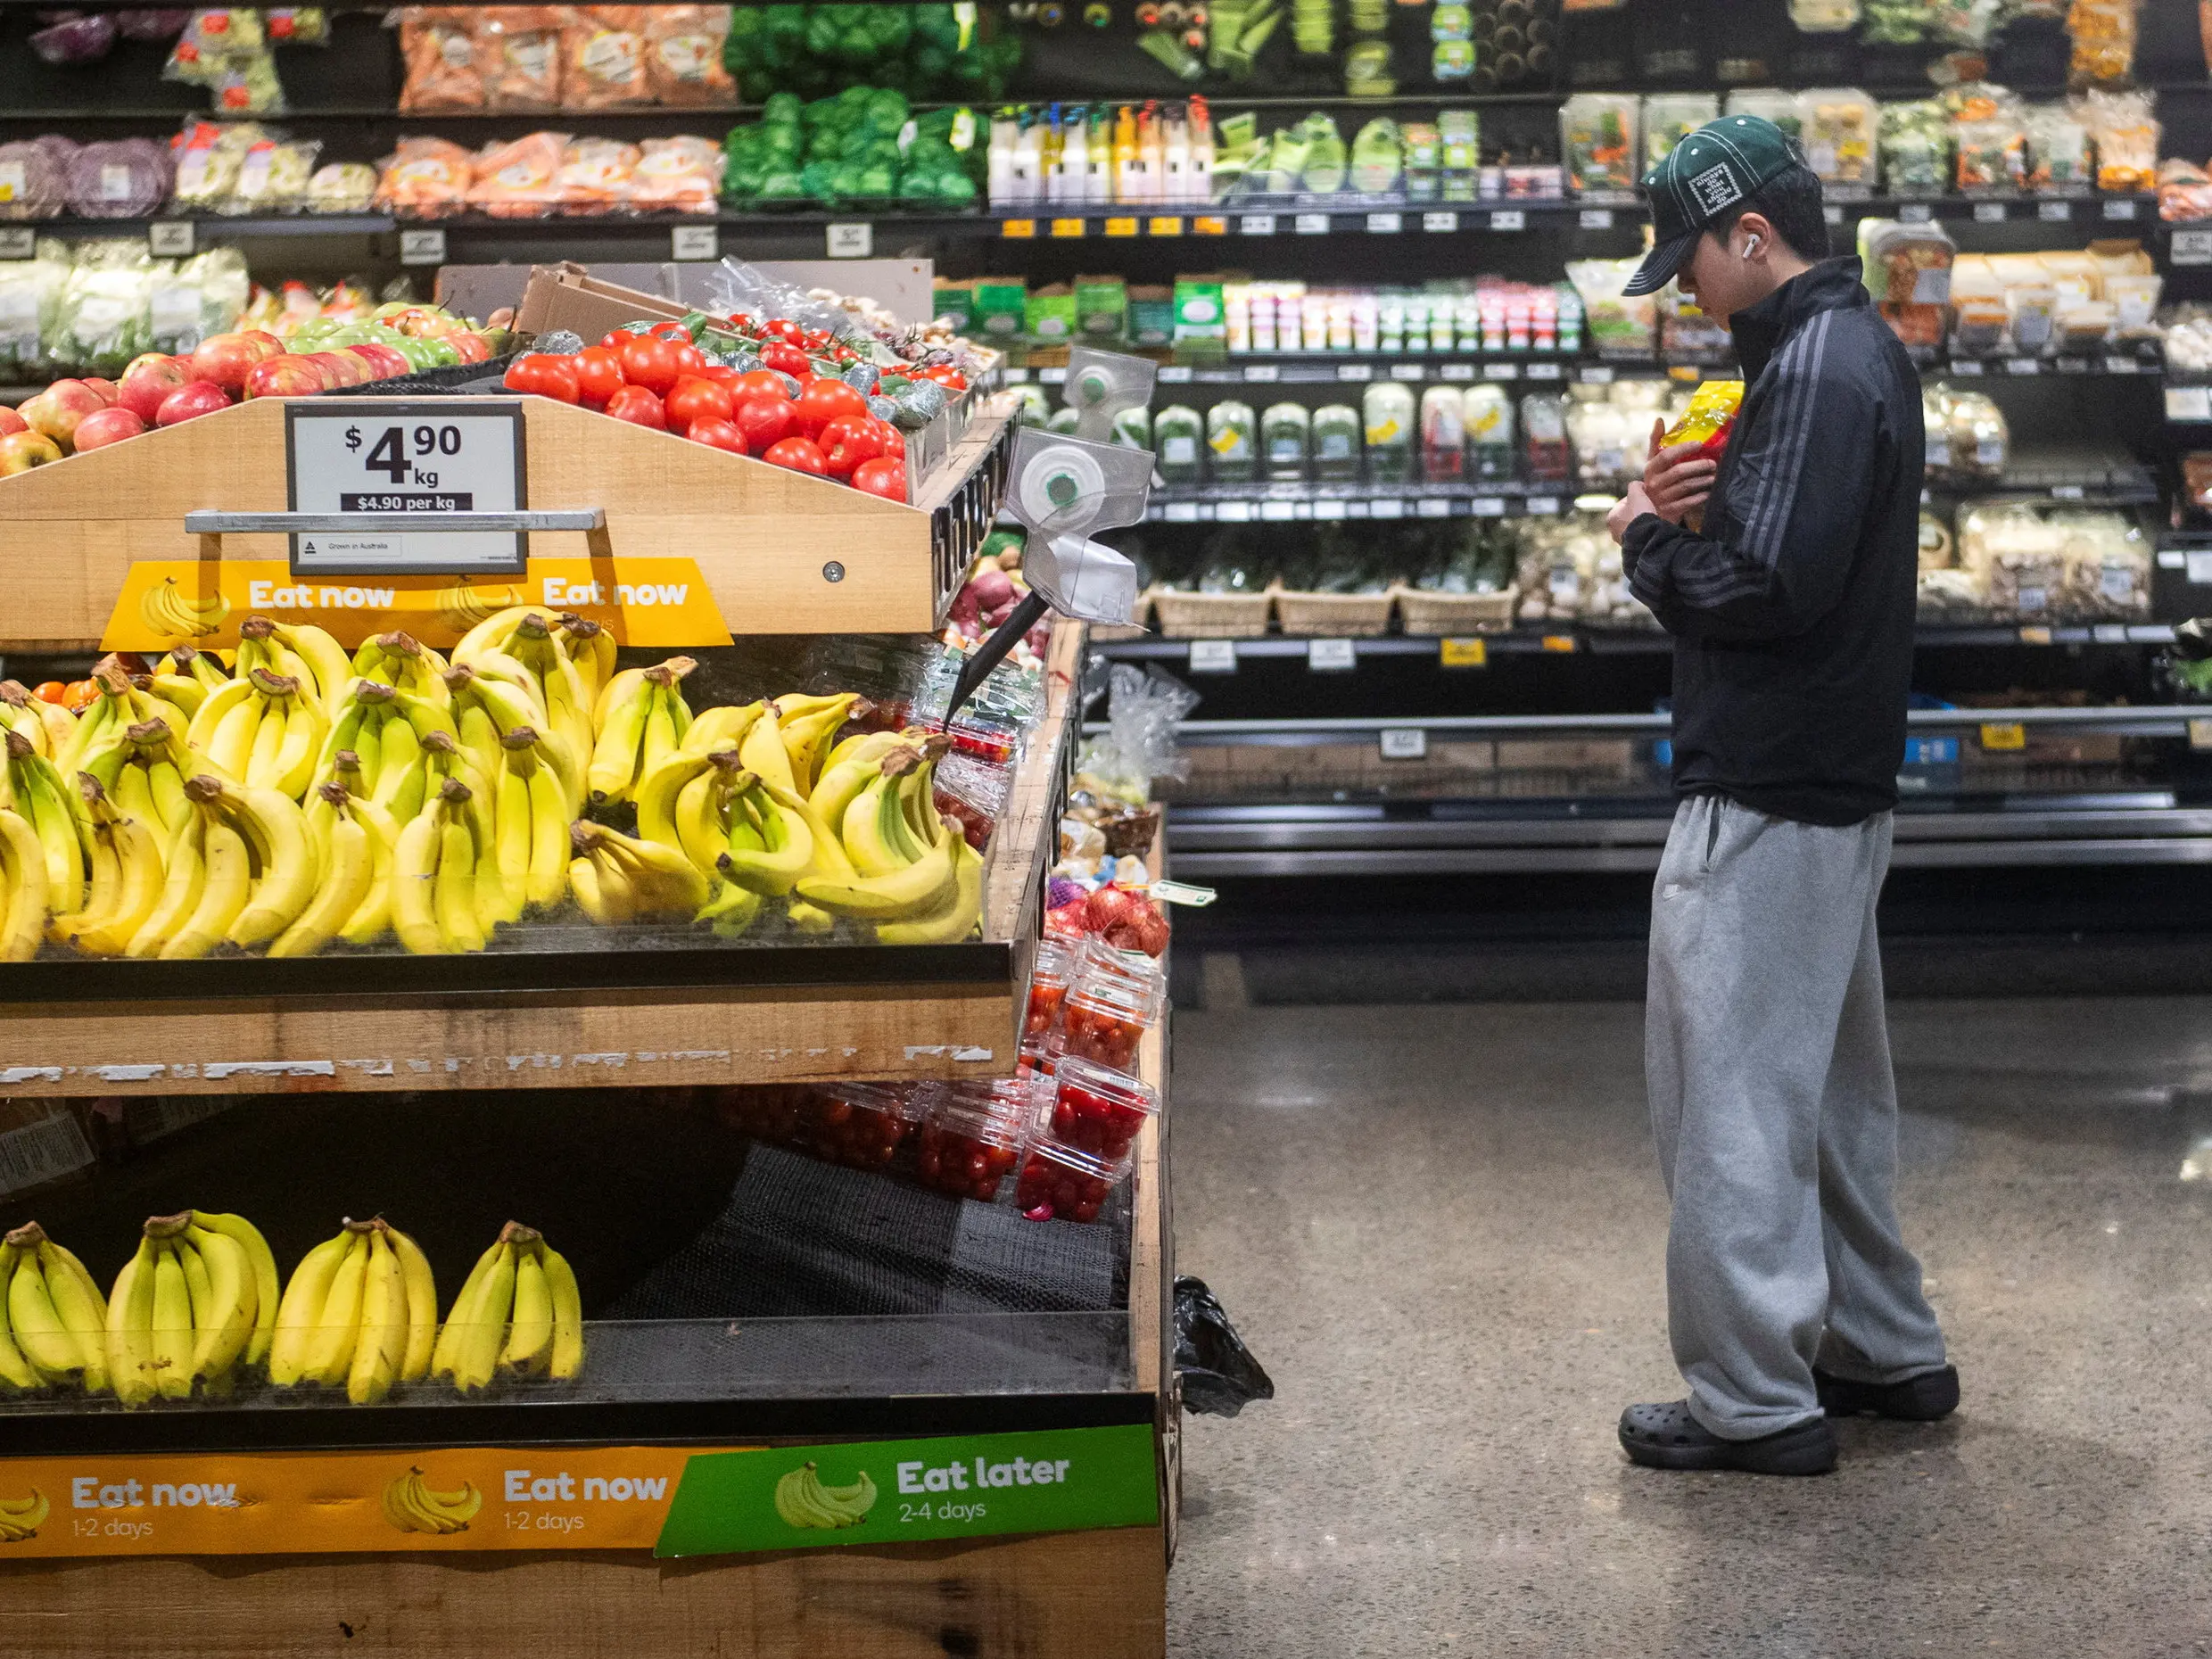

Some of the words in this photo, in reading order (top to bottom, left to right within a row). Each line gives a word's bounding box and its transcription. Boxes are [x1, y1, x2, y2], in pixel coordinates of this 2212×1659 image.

[1696, 169, 1723, 186] always
[1704, 178, 1725, 194] what
[415, 468, 438, 488] kg
[358, 496, 401, 511] $4.90
[406, 499, 433, 511] per
[436, 496, 456, 511] kg
[250, 581, 313, 608] Eat
[319, 587, 395, 608] now
[542, 578, 606, 606] Eat
[613, 584, 688, 606] now
[504, 1470, 576, 1501] Eat
[583, 1477, 668, 1501] now
[896, 1461, 969, 1494] Eat
[975, 1457, 1069, 1488] later
[72, 1477, 144, 1508] Eat
[151, 1483, 240, 1507] now
[504, 1512, 529, 1530] 1-2
[536, 1512, 584, 1534] days
[899, 1503, 932, 1523] 2-4
[937, 1501, 986, 1523] days
[72, 1518, 98, 1537] 1-2
[104, 1518, 153, 1539] days
